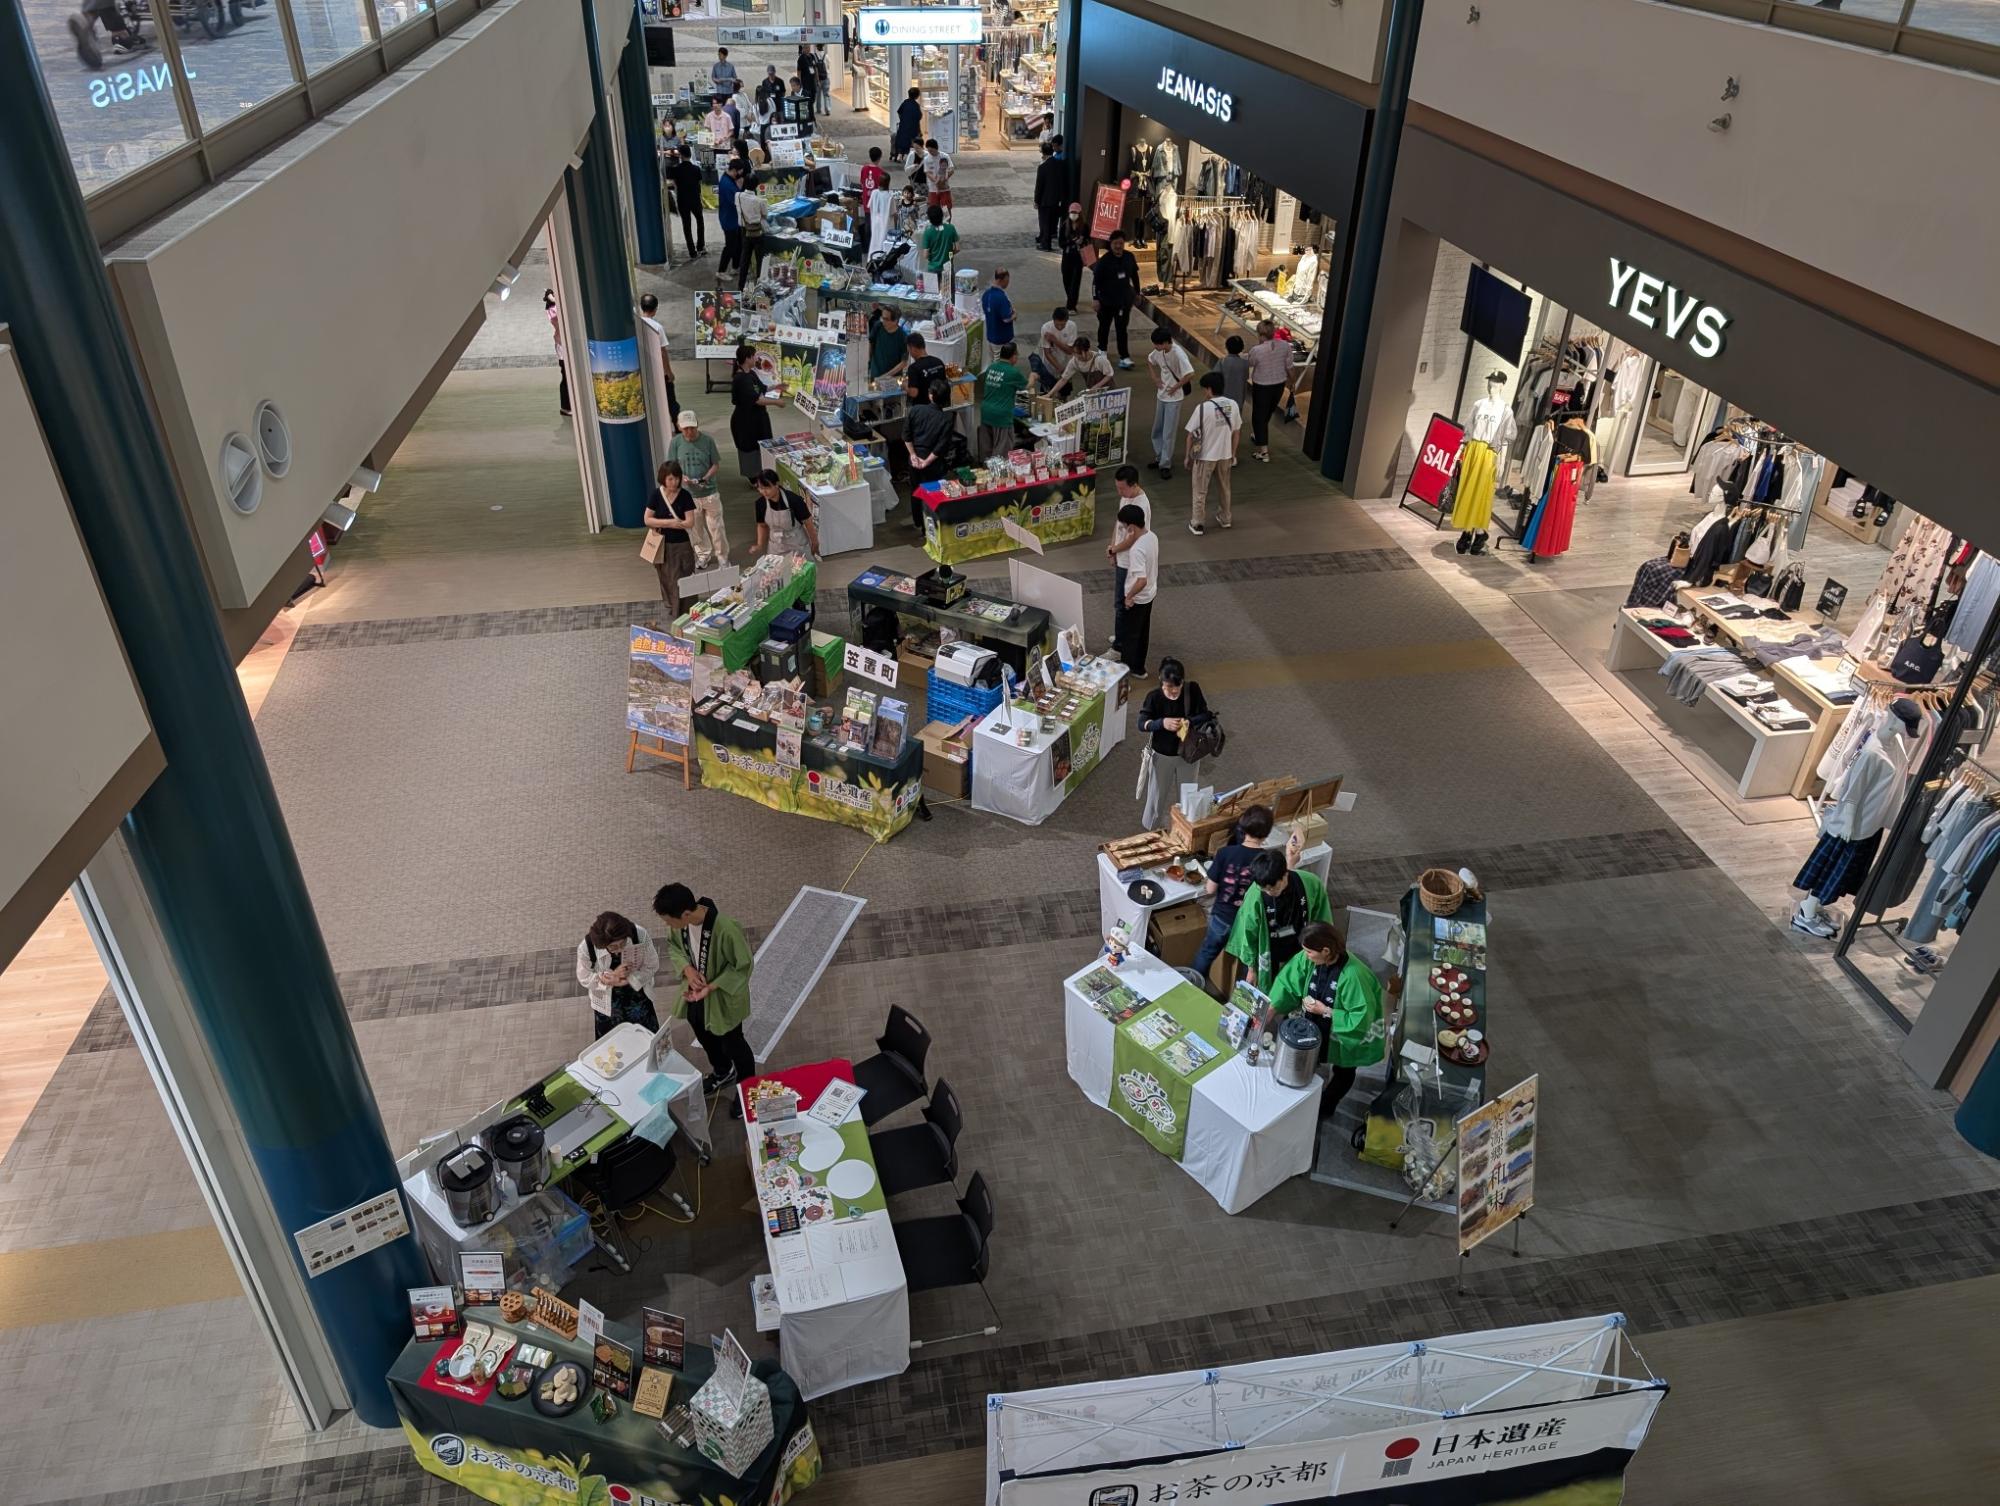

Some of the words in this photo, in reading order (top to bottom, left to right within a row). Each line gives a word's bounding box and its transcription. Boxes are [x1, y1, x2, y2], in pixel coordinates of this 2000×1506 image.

[891, 24, 926, 34] DINING
[929, 24, 961, 34] STREET
[1157, 66, 1232, 122] JEANASiS
[1100, 202, 1118, 219] SALE
[1608, 257, 1730, 359] YEVS
[1553, 392, 1570, 403] SALE
[847, 649, 895, 682] 笠置町
[1904, 660, 1921, 672] A.P.C.
[731, 752, 792, 781] お茶の京都
[825, 778, 872, 803] 日本遺産
[1431, 1418, 1567, 1457] 日本遺産
[469, 1446, 579, 1492] お茶の京都
[1426, 1456, 1476, 1470] JAPAN
[1481, 1441, 1559, 1461] HERITAGE
[1149, 1461, 1328, 1503] お茶の京都
